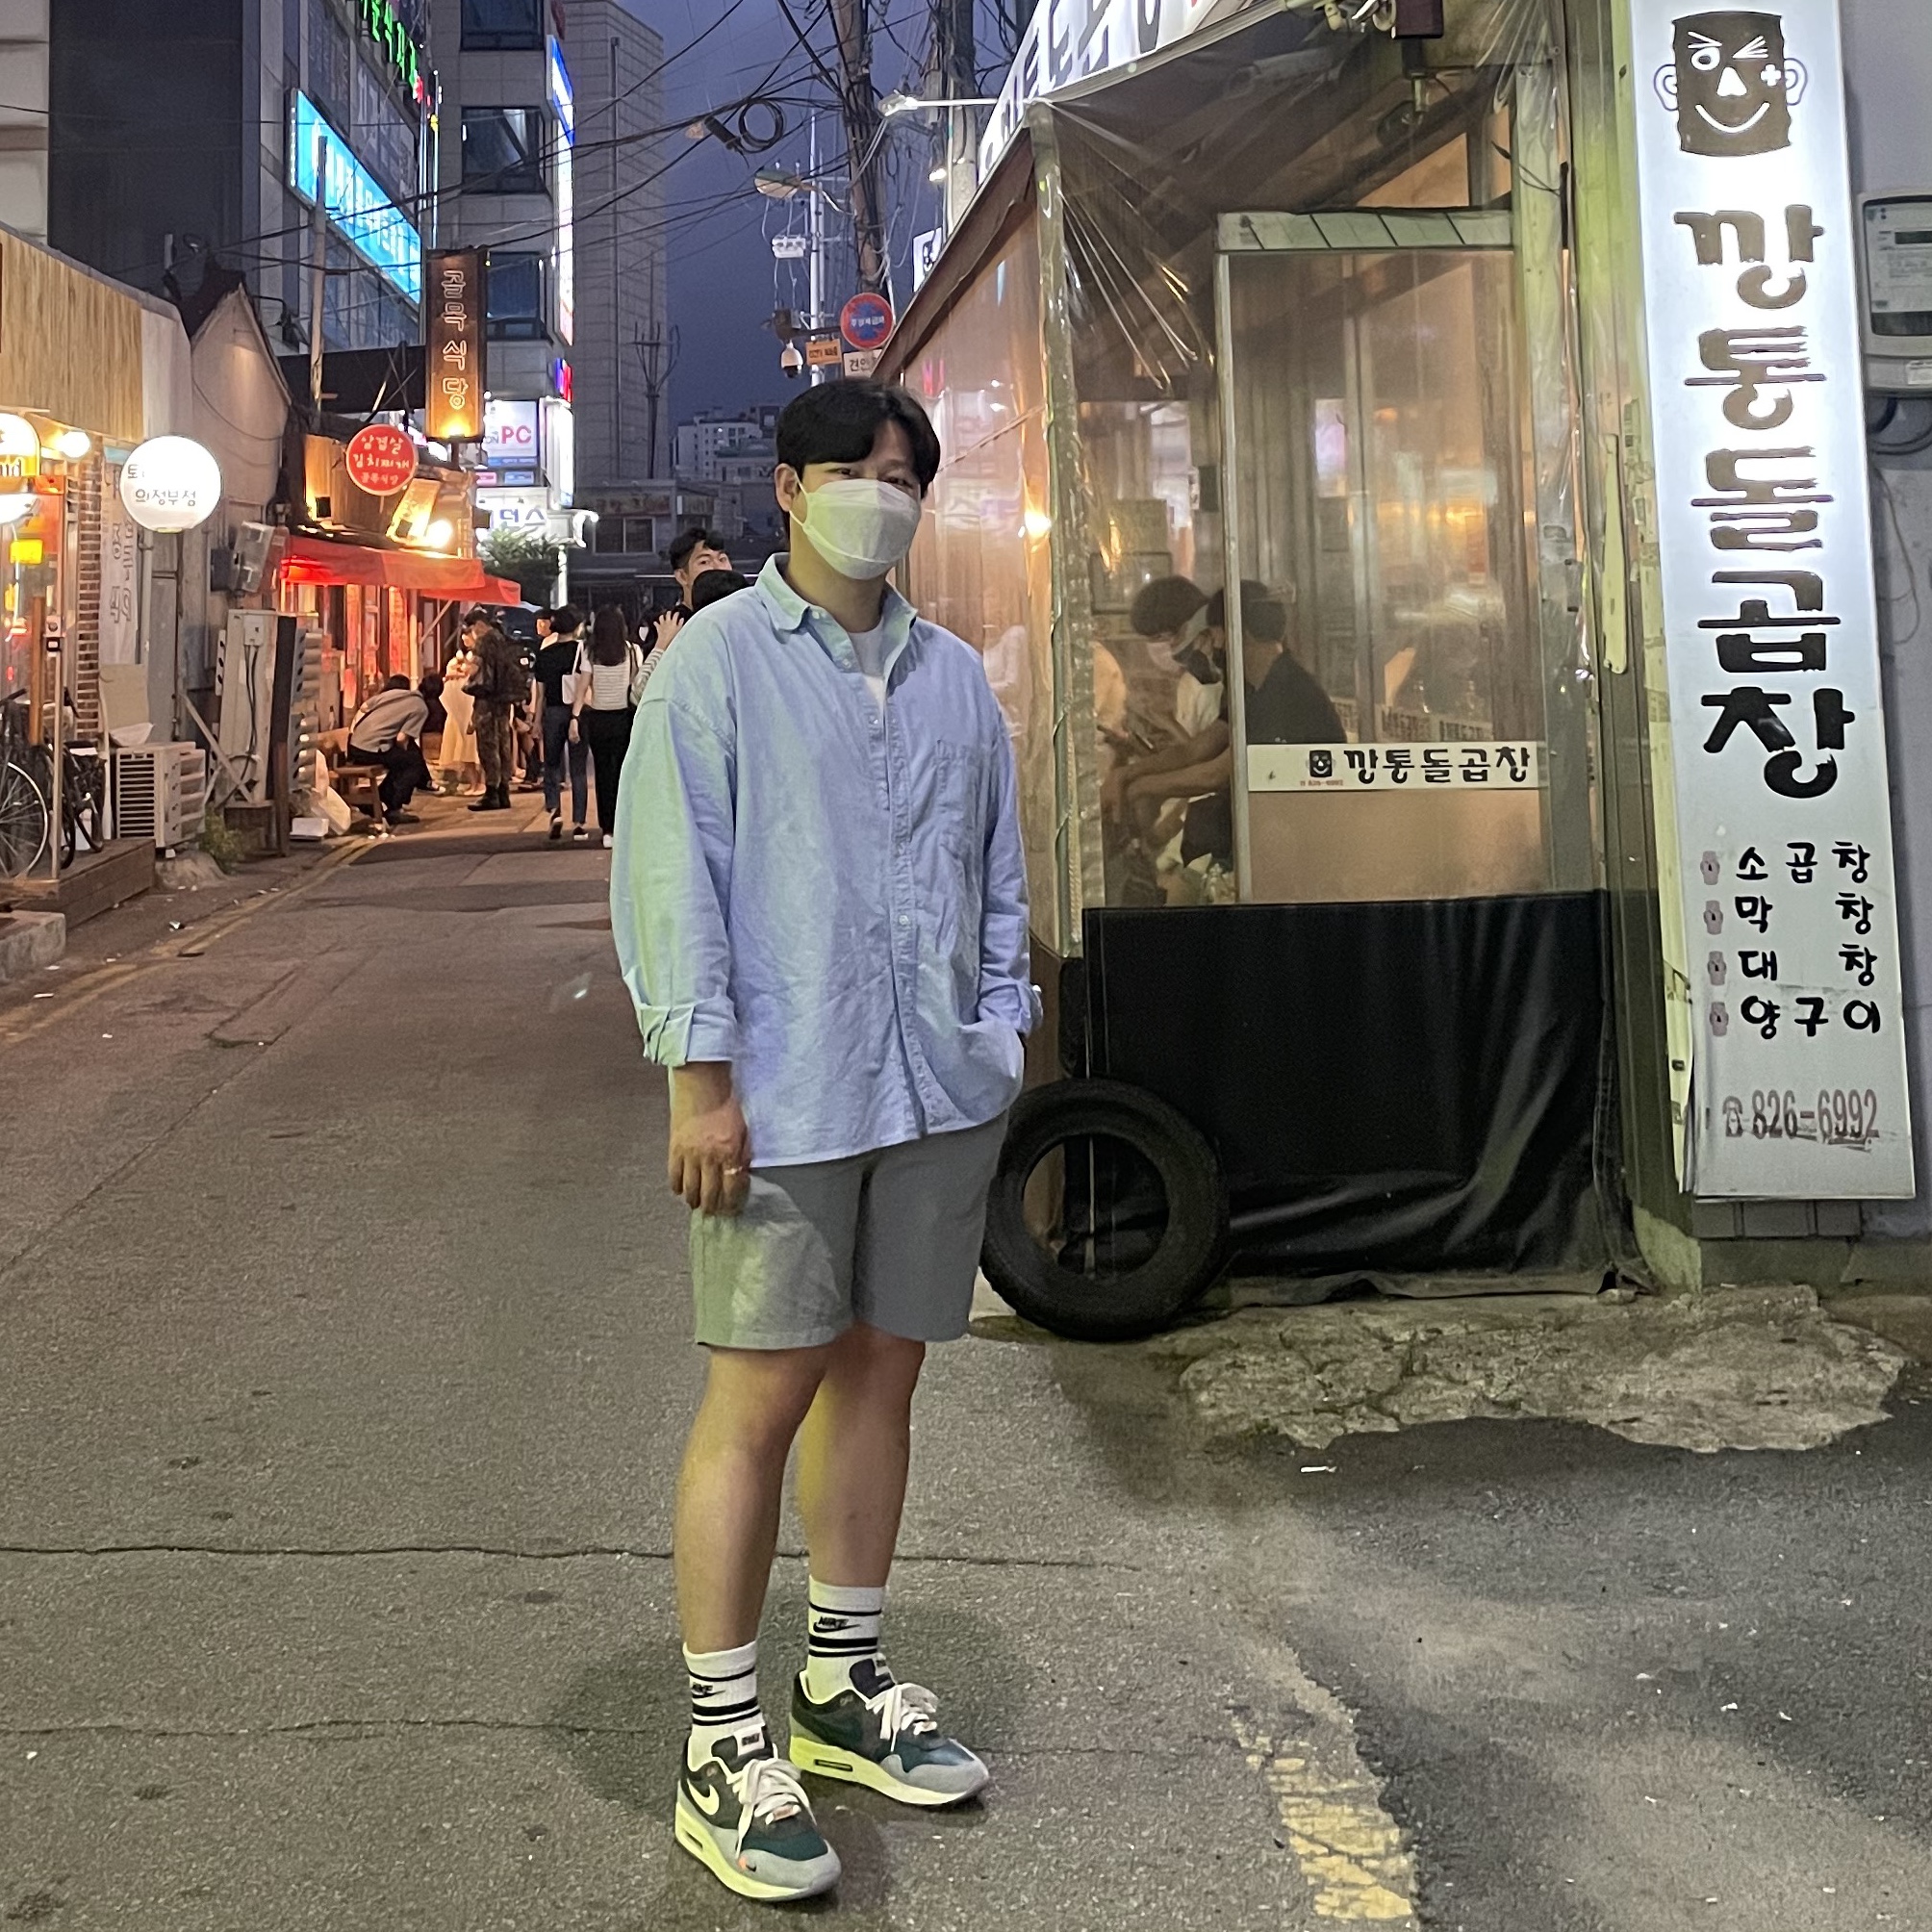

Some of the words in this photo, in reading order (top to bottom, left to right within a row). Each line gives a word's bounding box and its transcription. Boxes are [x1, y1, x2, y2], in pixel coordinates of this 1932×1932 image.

[441, 269, 469, 410] 골목식당
[361, 435, 403, 454] 삼겹살
[501, 425, 531, 444] PC
[352, 453, 410, 469] 김치찌개
[1672, 204, 1856, 800] 깡통돌곱창
[1342, 746, 1531, 785] 깡통돌곱창
[1751, 1088, 1880, 1139] 826-6992
